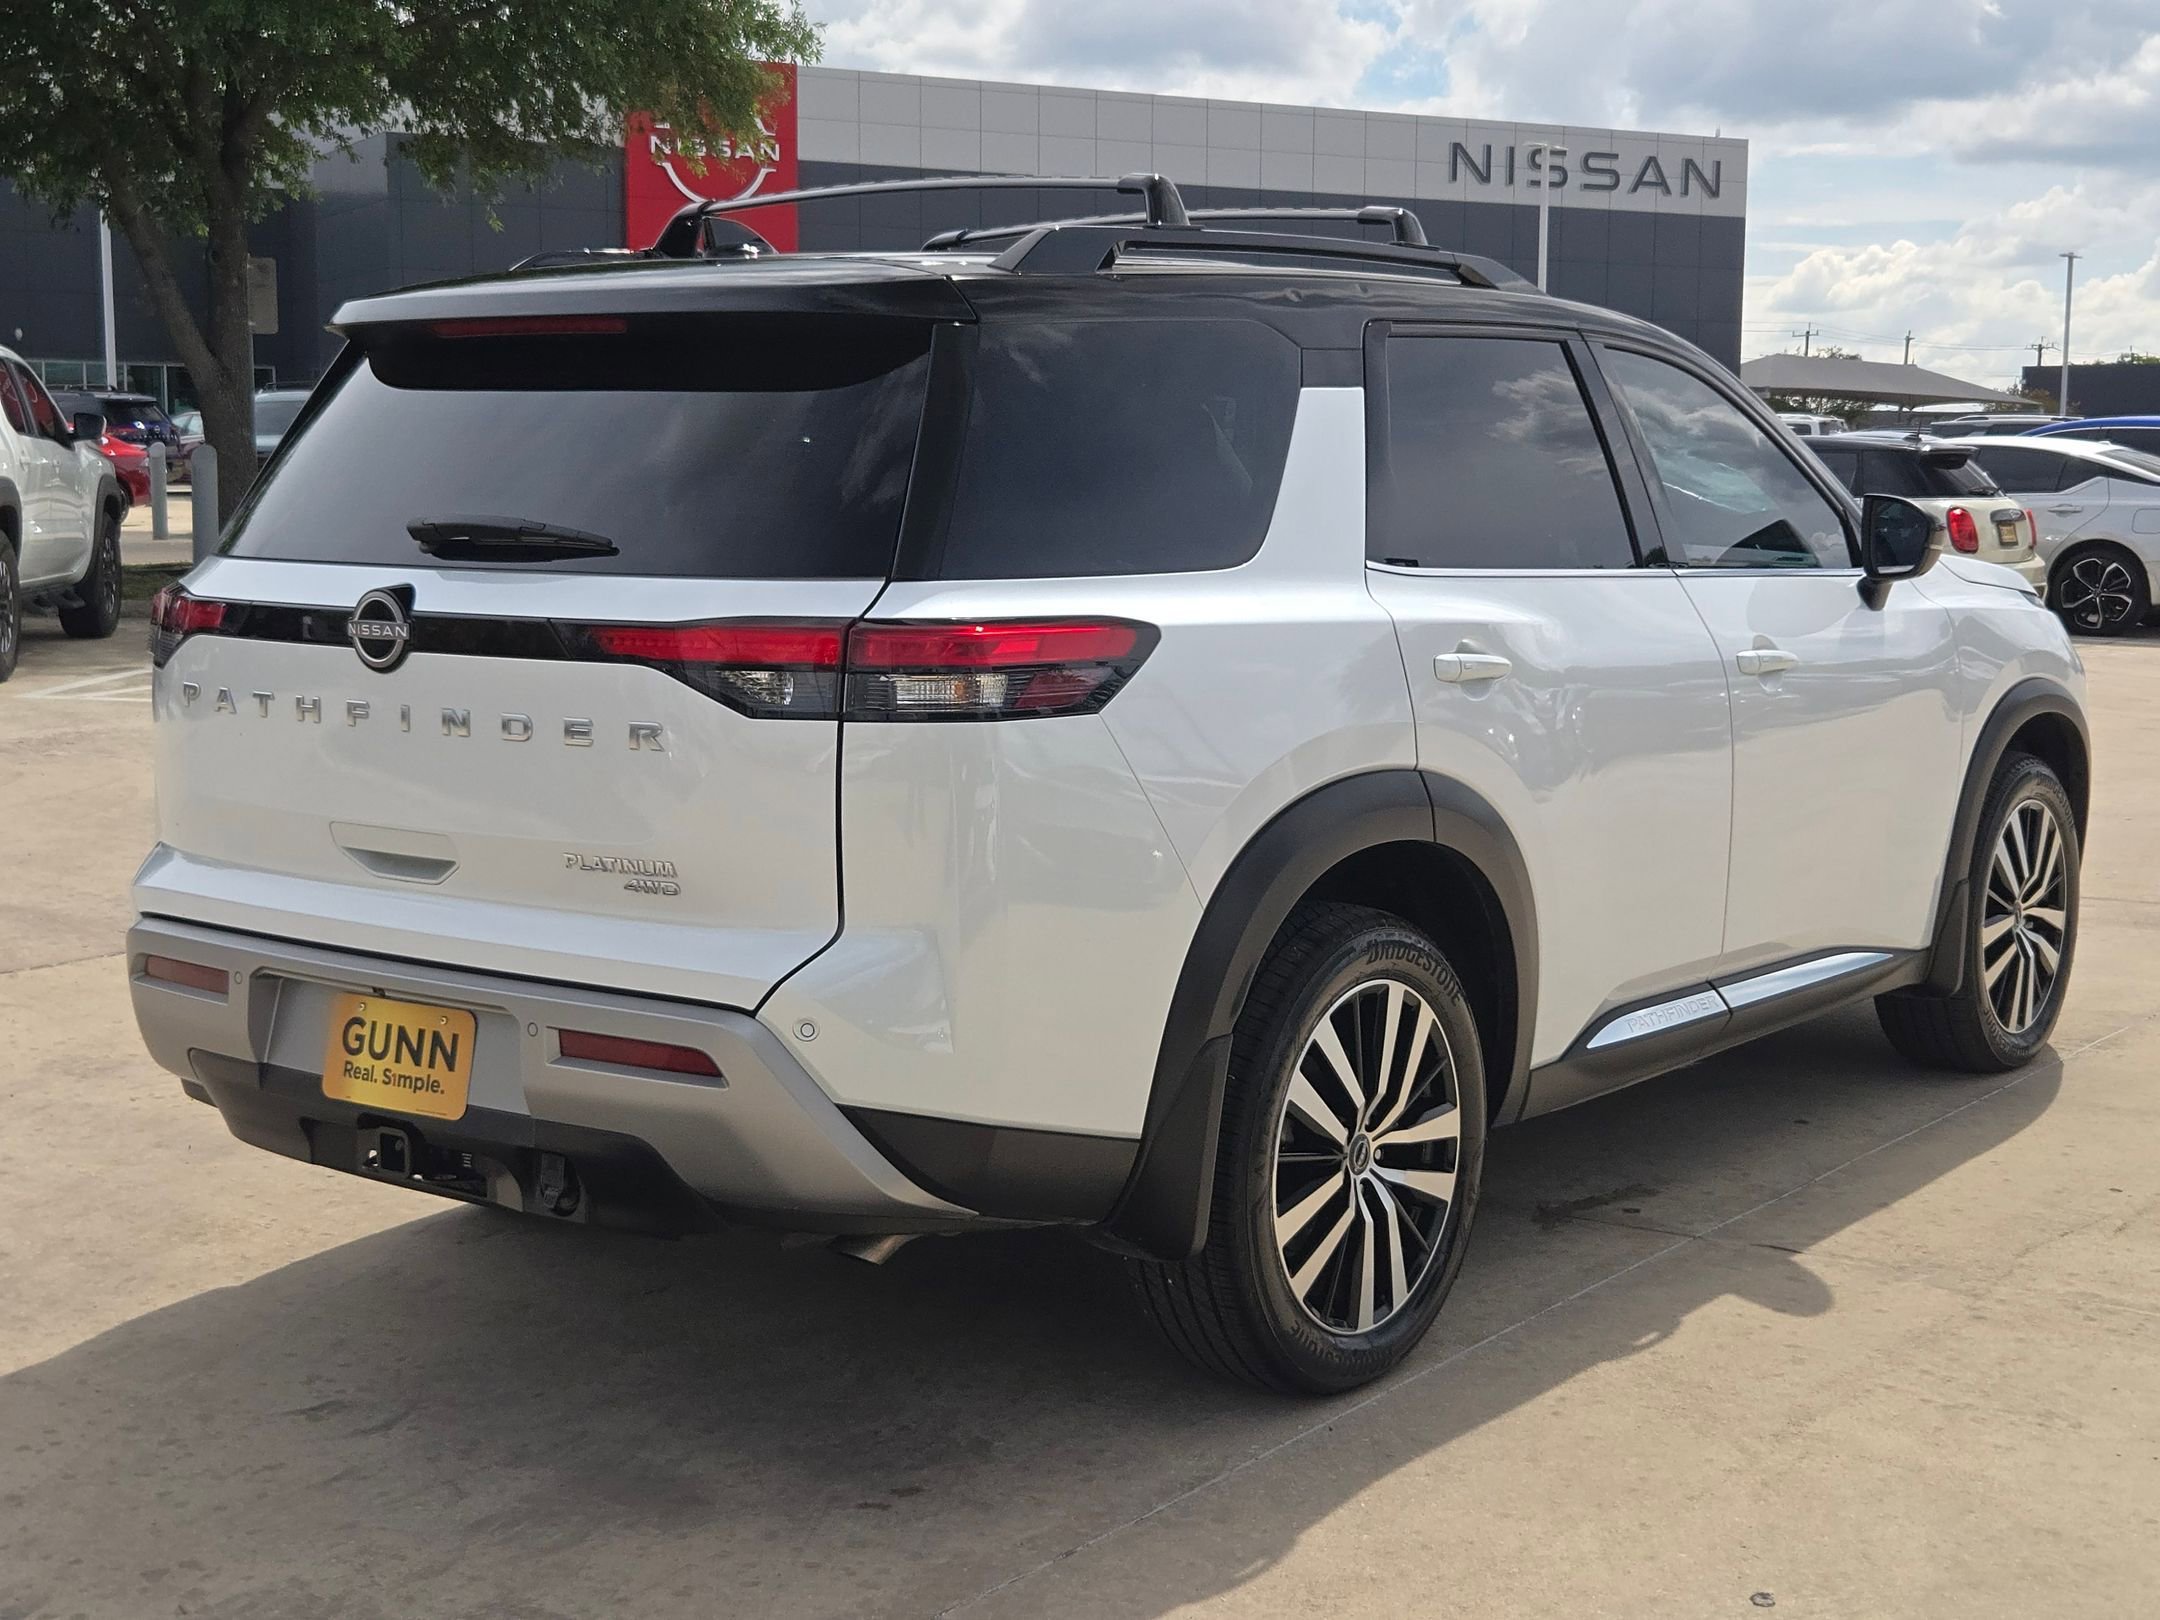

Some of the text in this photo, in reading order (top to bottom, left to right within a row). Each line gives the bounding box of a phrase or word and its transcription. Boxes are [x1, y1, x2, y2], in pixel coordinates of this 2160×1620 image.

[1449, 142, 1721, 198] NISSAN
[348, 622, 407, 637] NISSAN
[182, 681, 664, 752] PATHFINDER
[563, 852, 678, 878] PLATINUM
[623, 878, 681, 896] 4WD
[1625, 995, 1721, 1033] PATHFINDER
[342, 1016, 460, 1072] GUNN
[343, 1060, 378, 1084] Real.
